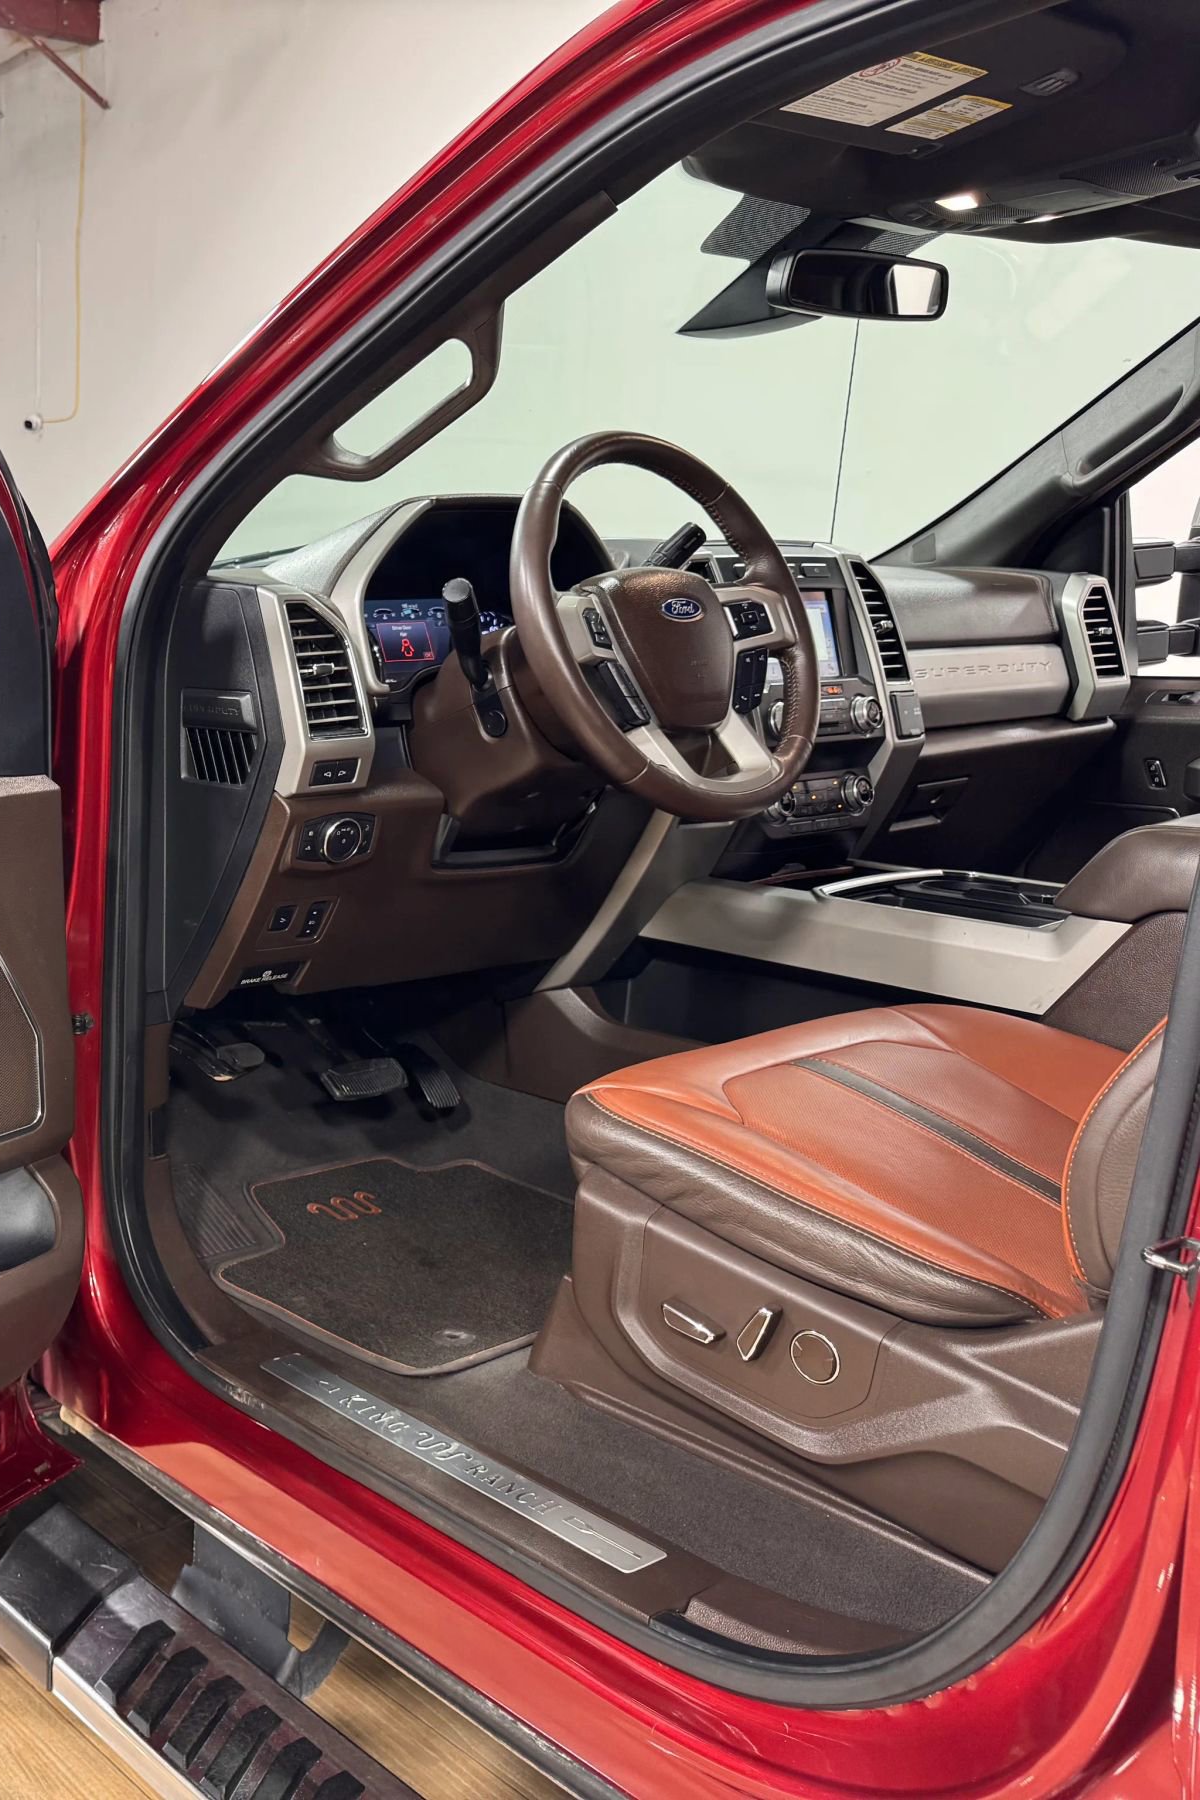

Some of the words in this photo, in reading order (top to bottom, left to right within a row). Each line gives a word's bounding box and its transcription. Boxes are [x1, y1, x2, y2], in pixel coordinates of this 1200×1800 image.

[671, 600, 695, 614] Ford
[914, 664, 992, 678] SUPER
[997, 661, 1050, 673] DUTY
[261, 973, 288, 981] RELEASE
[340, 1394, 409, 1434] KING
[464, 1461, 562, 1516] RANCH
